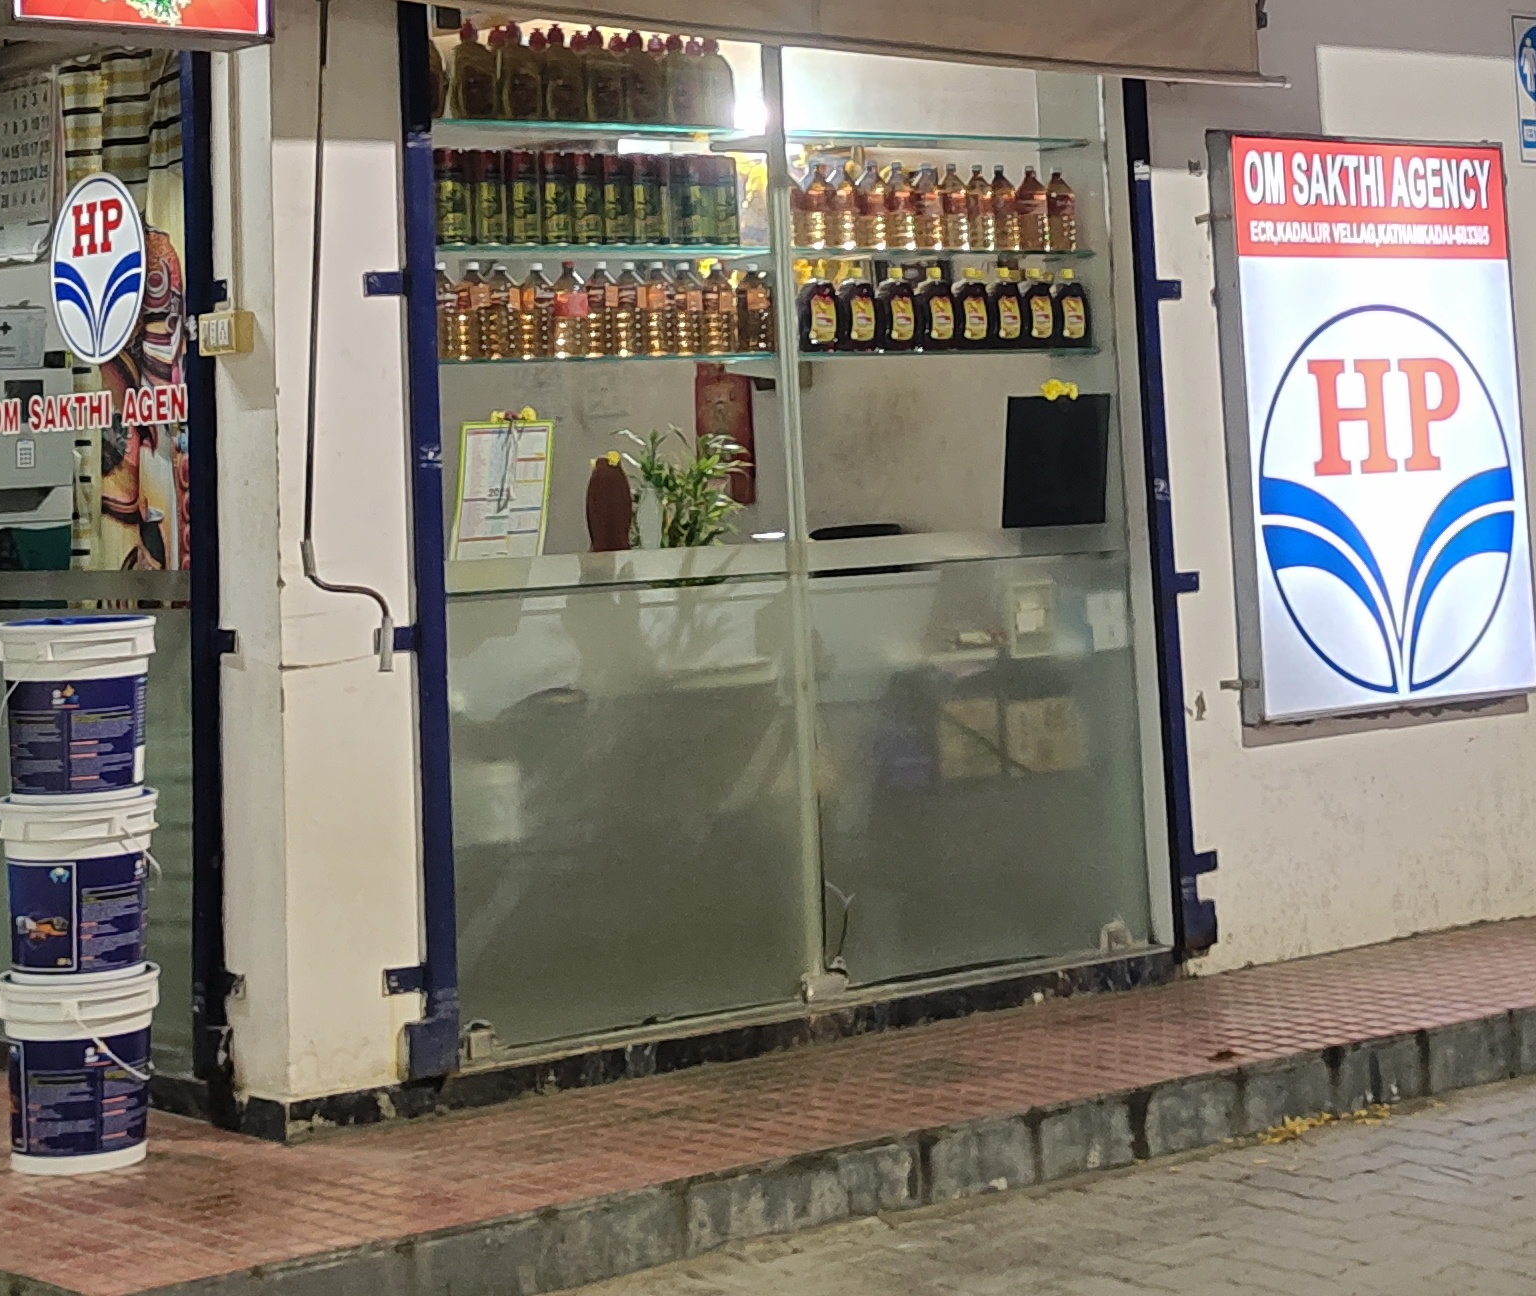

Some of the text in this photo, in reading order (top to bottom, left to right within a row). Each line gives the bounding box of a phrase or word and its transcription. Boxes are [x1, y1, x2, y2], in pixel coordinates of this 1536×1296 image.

[1243, 149, 1490, 210] OM SAKTHI AGENCY
[71, 197, 123, 258] HP
[29, 394, 112, 432] SAKTHI
[1307, 356, 1461, 478] HP
